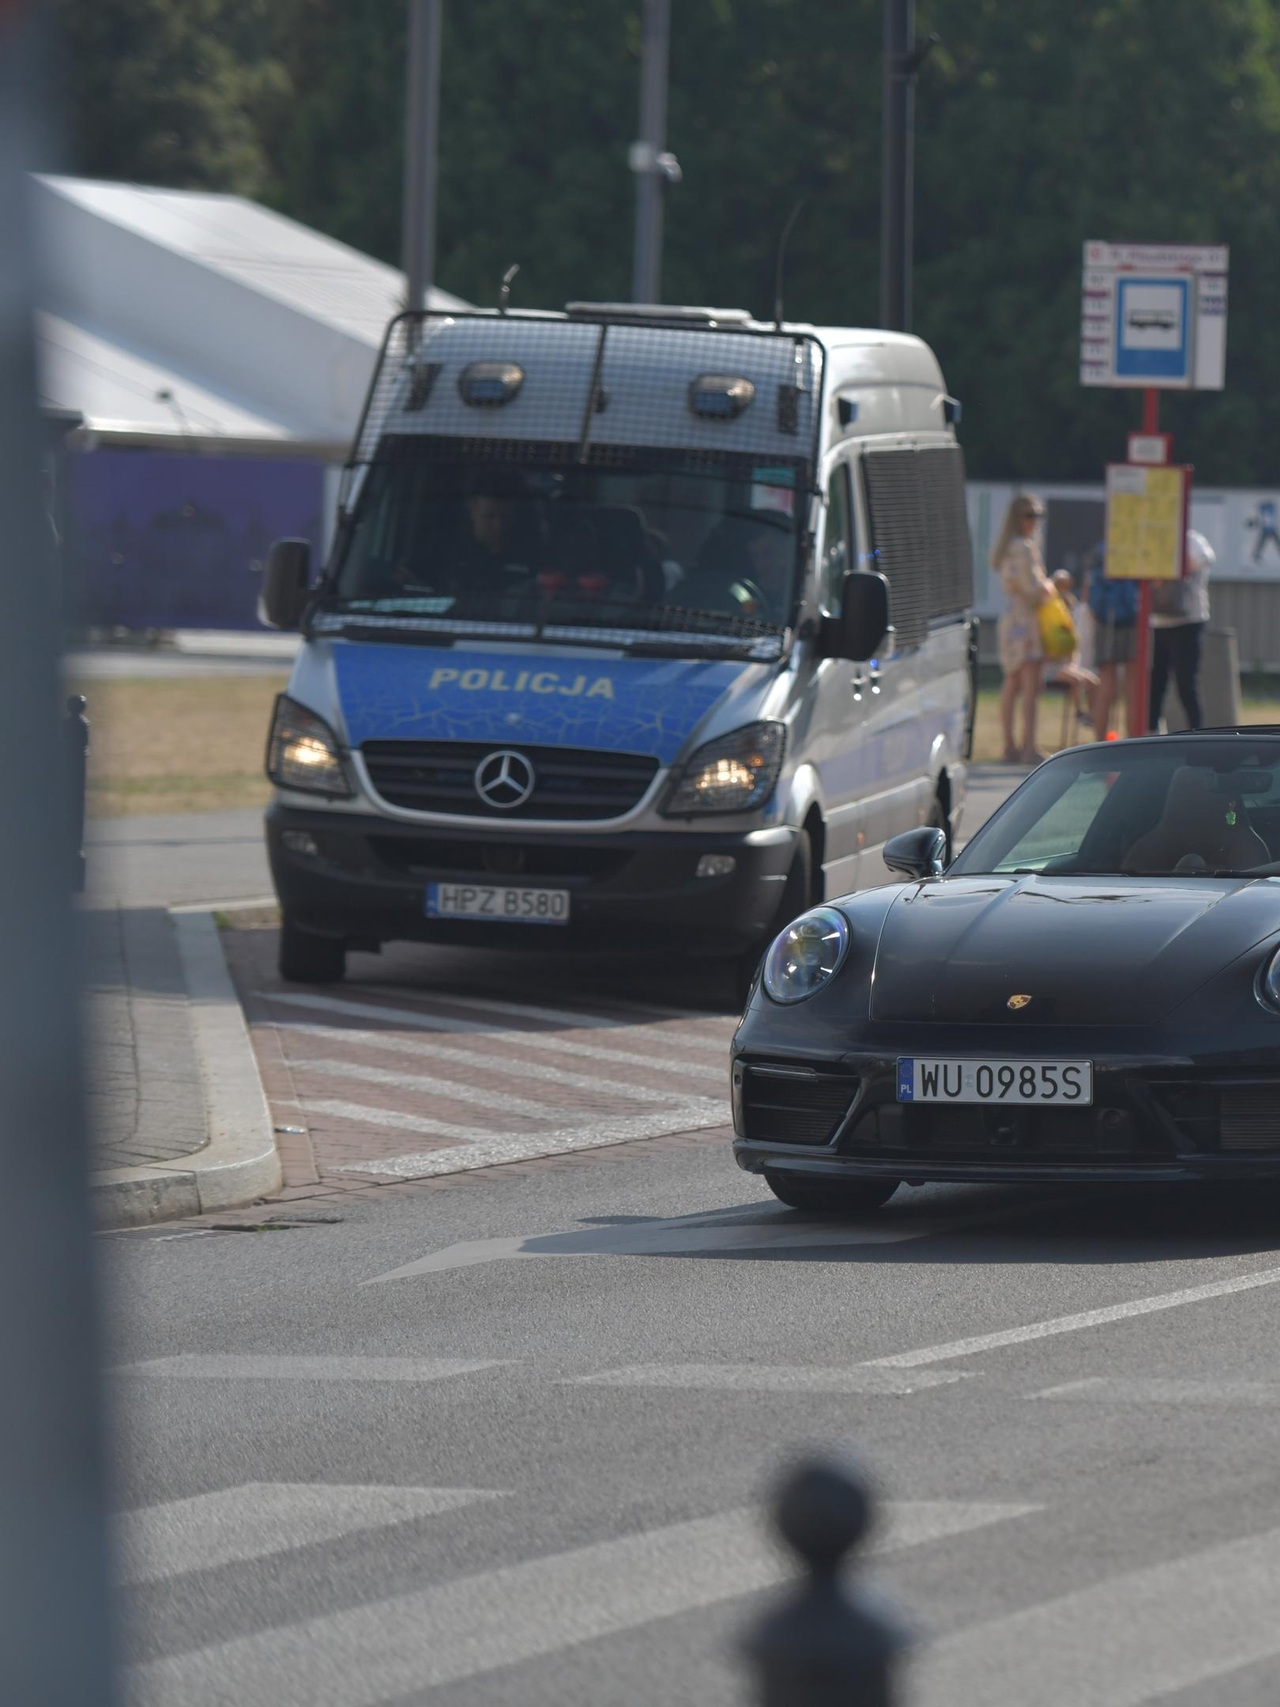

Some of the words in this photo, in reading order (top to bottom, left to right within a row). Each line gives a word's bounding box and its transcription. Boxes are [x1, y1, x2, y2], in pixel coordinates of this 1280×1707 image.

[428, 667, 615, 700] POLICJA
[441, 887, 496, 914] HPZ
[504, 890, 565, 916] B580
[900, 1084, 912, 1094] PL
[921, 1063, 962, 1098] WU
[976, 1065, 1081, 1100] 0985S
